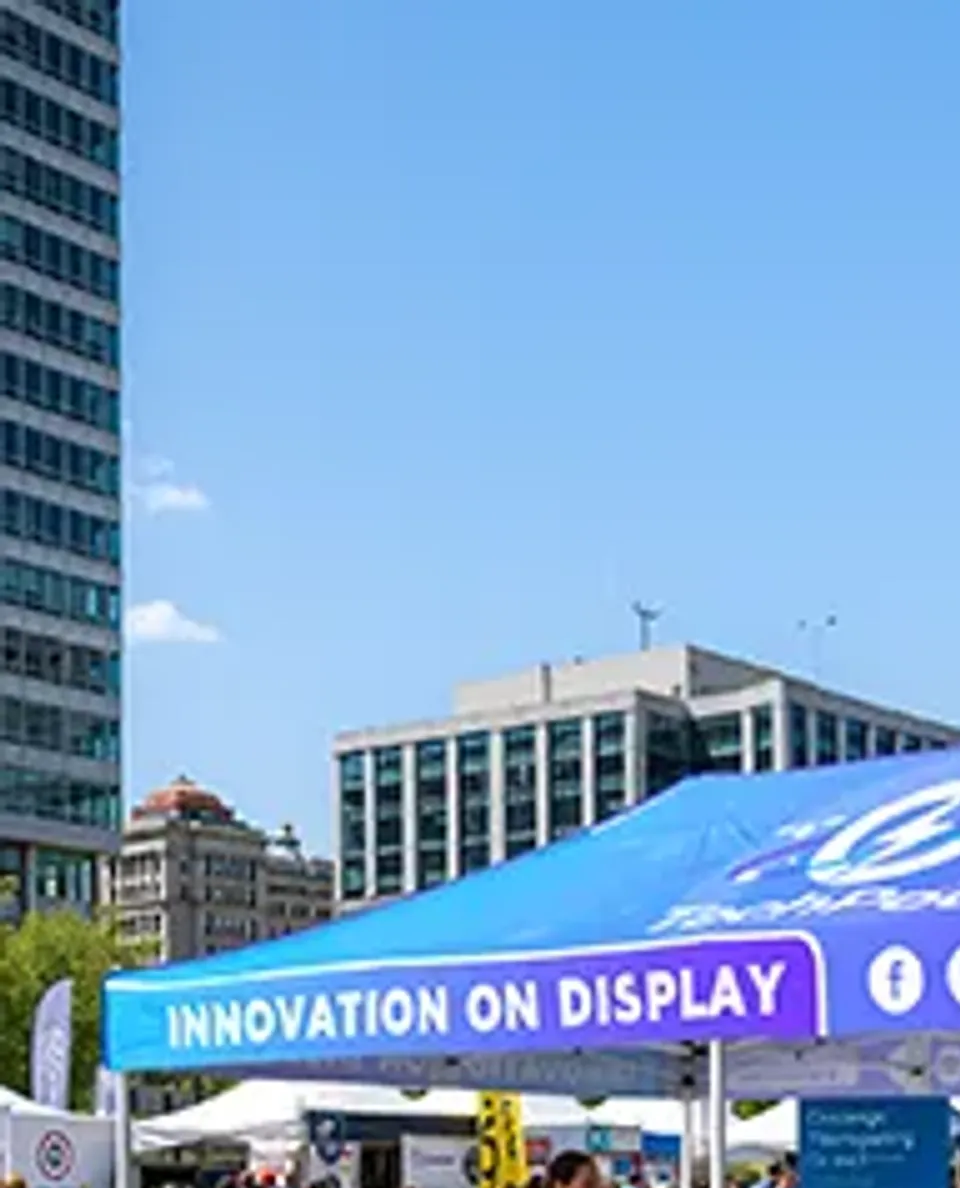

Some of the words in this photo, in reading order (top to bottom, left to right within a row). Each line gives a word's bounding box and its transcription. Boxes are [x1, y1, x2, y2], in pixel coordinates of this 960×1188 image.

[166, 984, 449, 1049] INNOVATION
[464, 979, 540, 1033] ON
[558, 961, 786, 1029] DISPLAY
